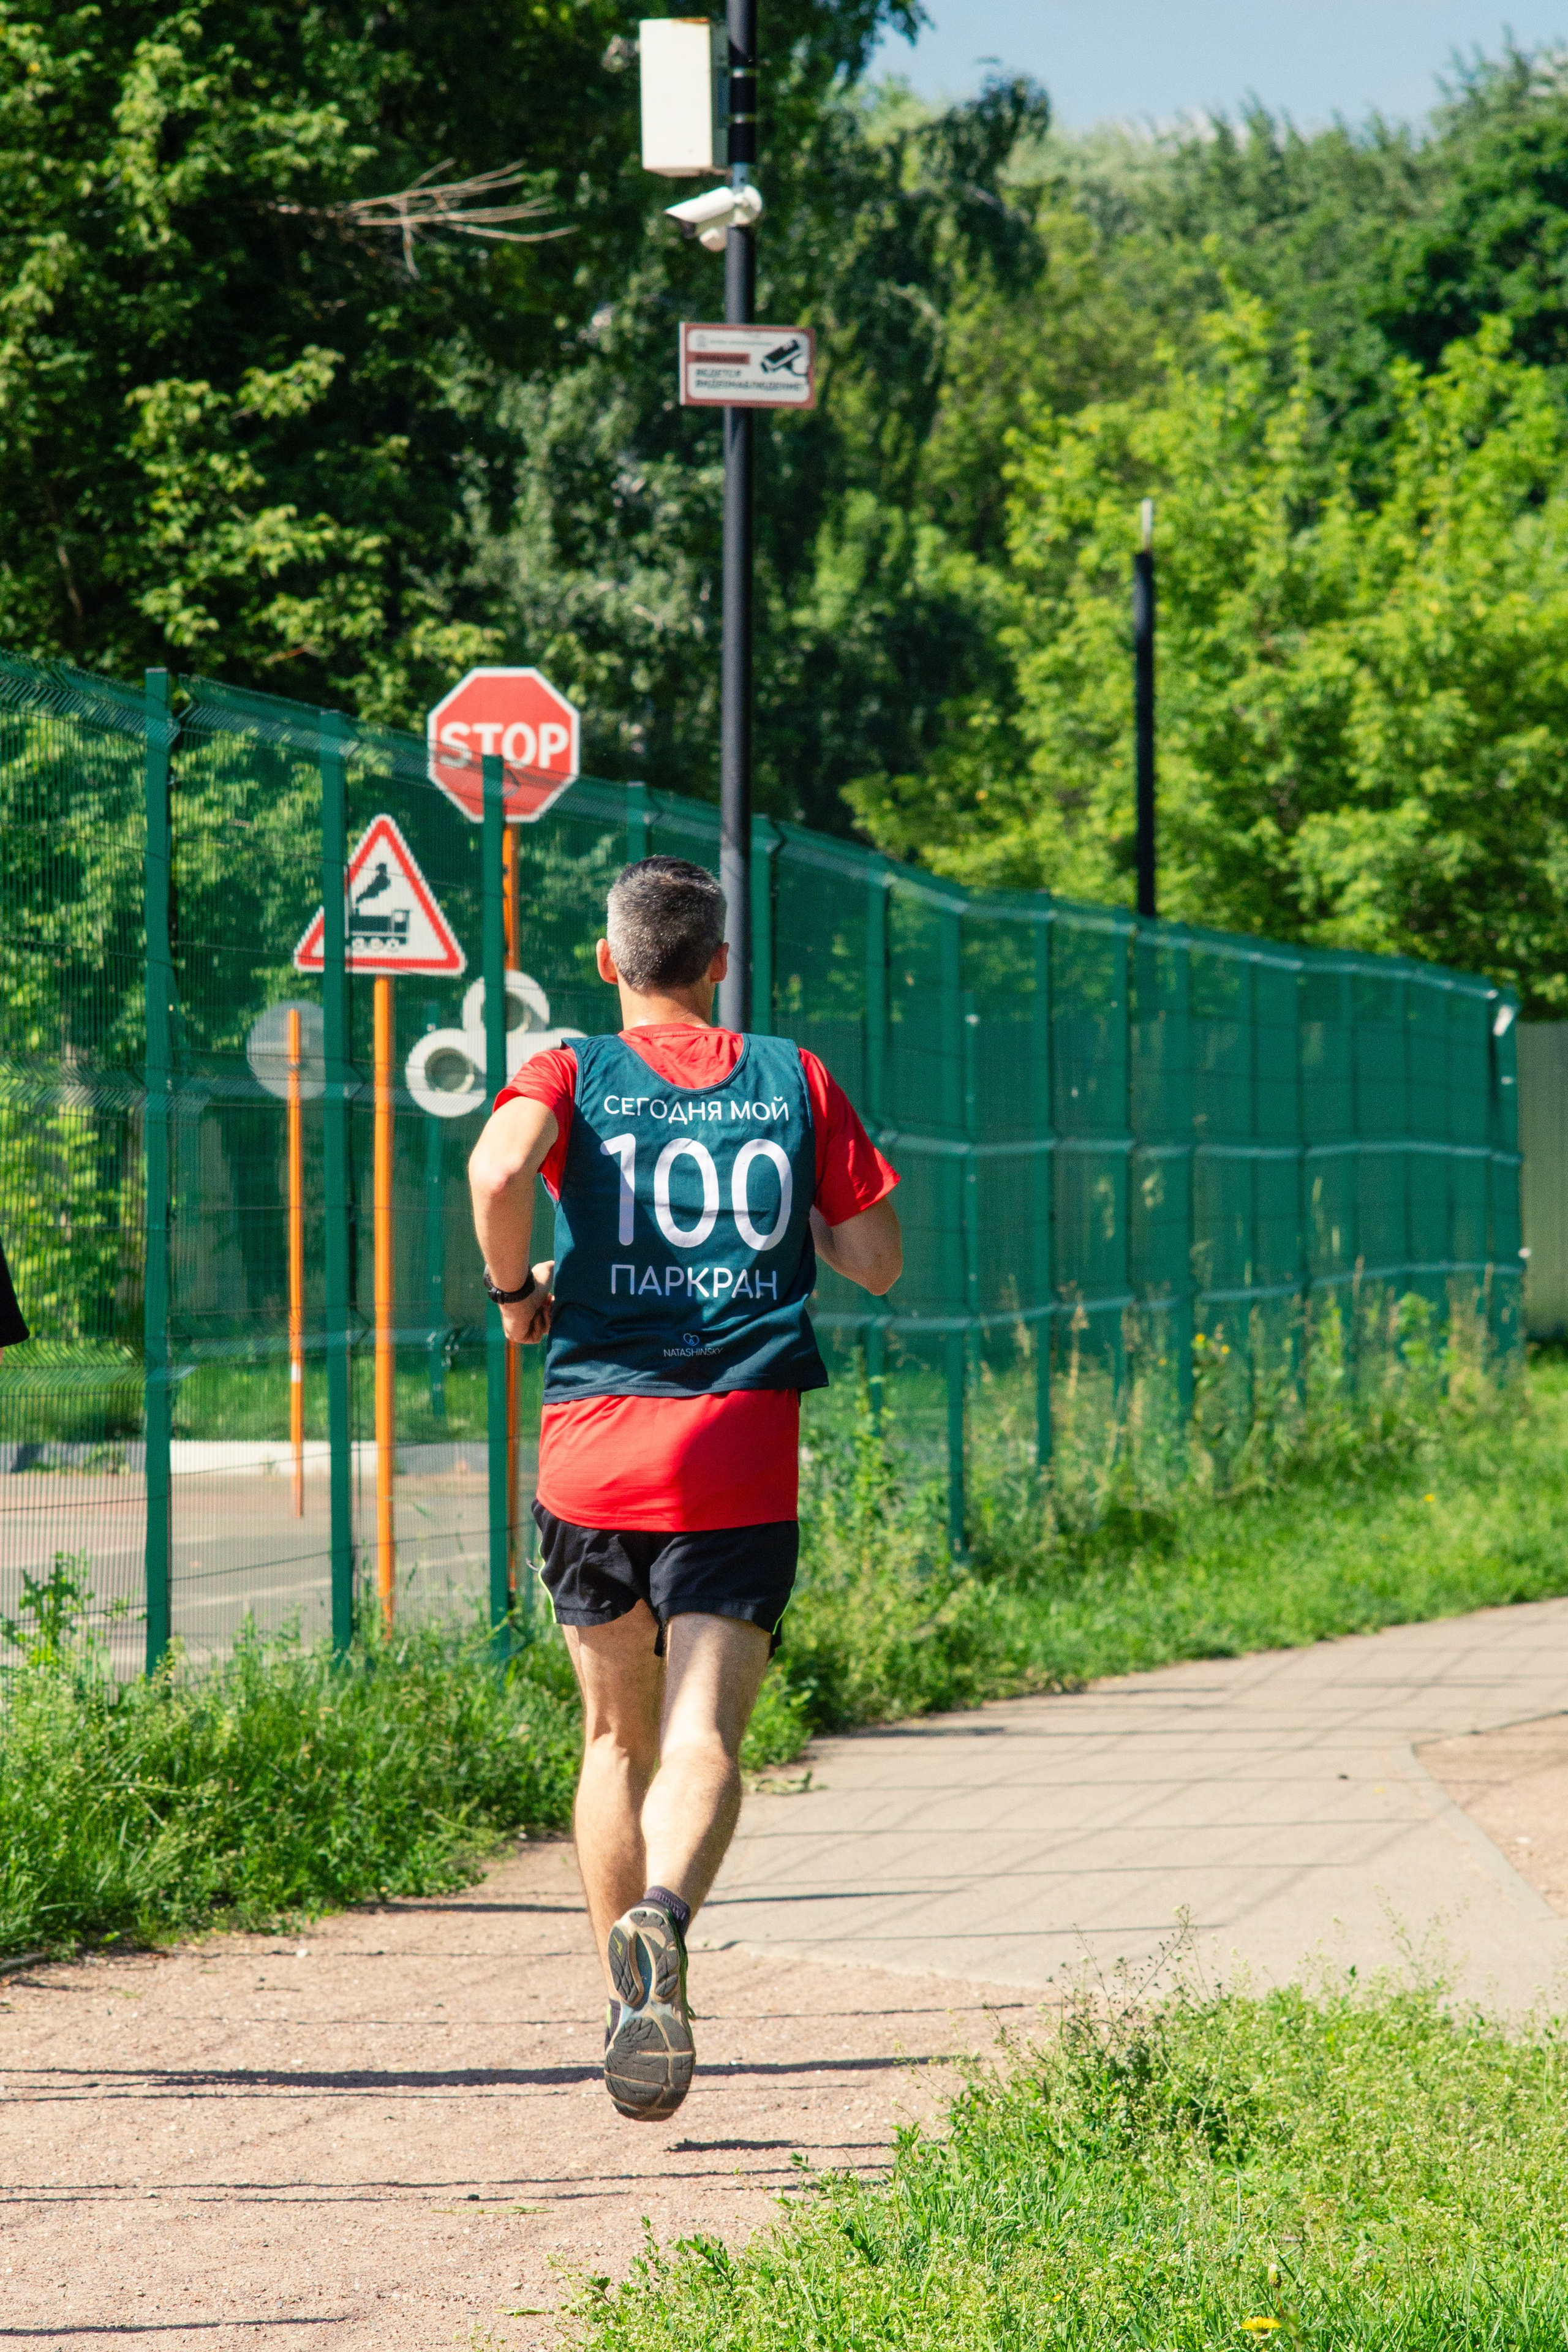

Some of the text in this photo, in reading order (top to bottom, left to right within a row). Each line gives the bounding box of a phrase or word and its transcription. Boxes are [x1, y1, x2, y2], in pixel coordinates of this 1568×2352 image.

[440, 722, 570, 769] STOP
[604, 1095, 790, 1125] СЕГОДНЯ МОЙ
[600, 1133, 793, 1251] 100
[611, 1264, 778, 1300] ПАРКРАН
[663, 1348, 723, 1357] NATASHINSKY
